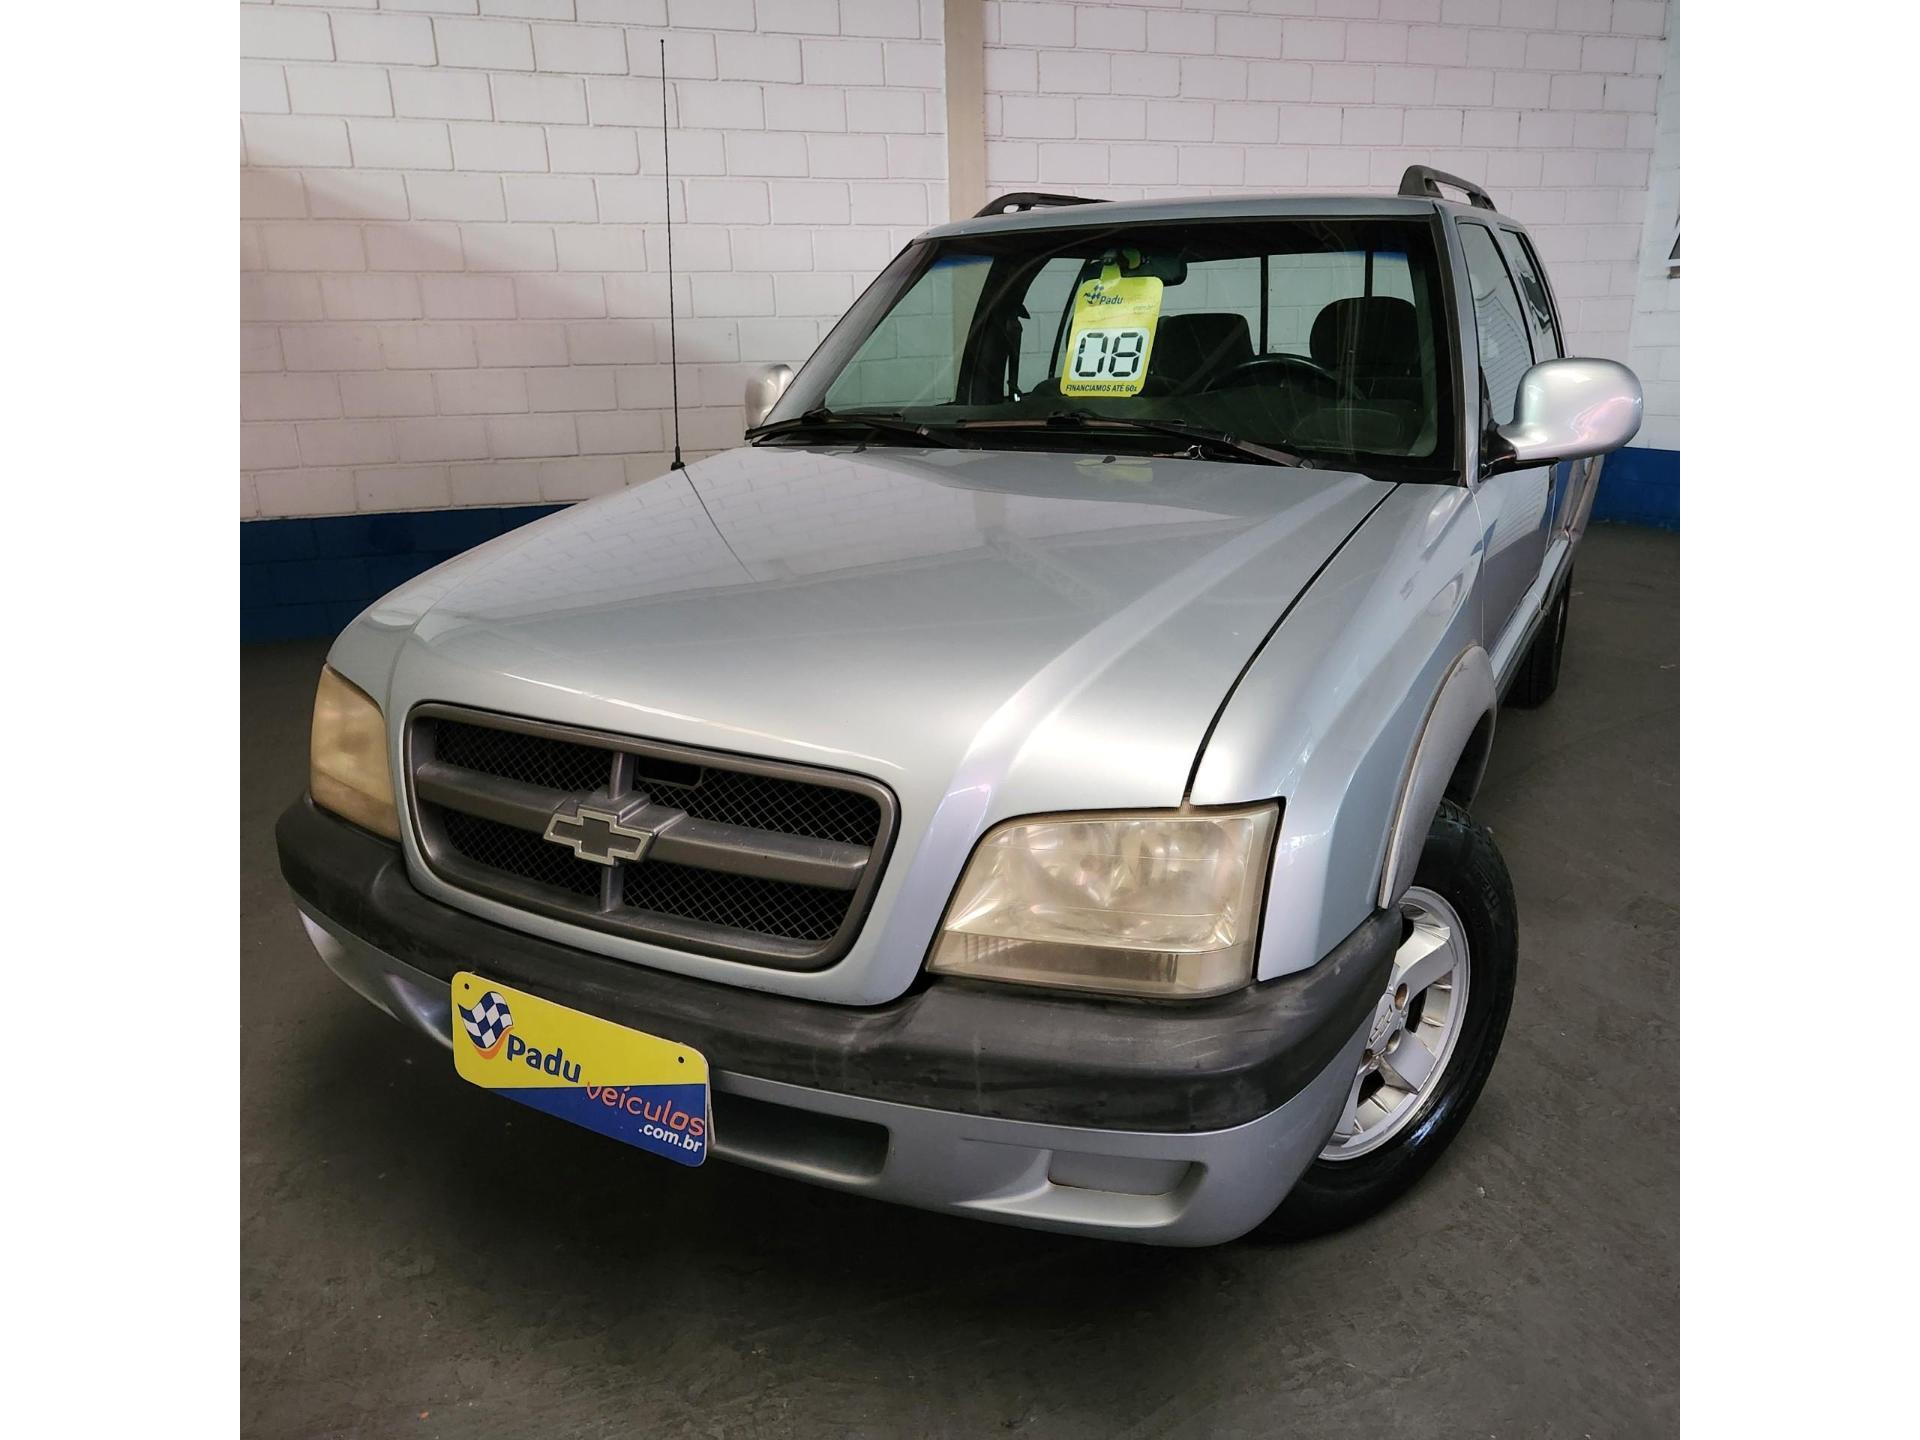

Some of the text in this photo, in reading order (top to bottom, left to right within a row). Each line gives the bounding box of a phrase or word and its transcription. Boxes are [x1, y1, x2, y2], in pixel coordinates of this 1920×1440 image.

[1100, 295, 1123, 305] Padu
[1075, 332, 1143, 377] 08
[1066, 384, 1111, 392] FINANCIAMOS
[1112, 383, 1123, 392] ATÉ
[506, 1033, 582, 1083] Padu
[586, 1081, 705, 1137] veículos
[638, 1123, 703, 1154] .com.br
